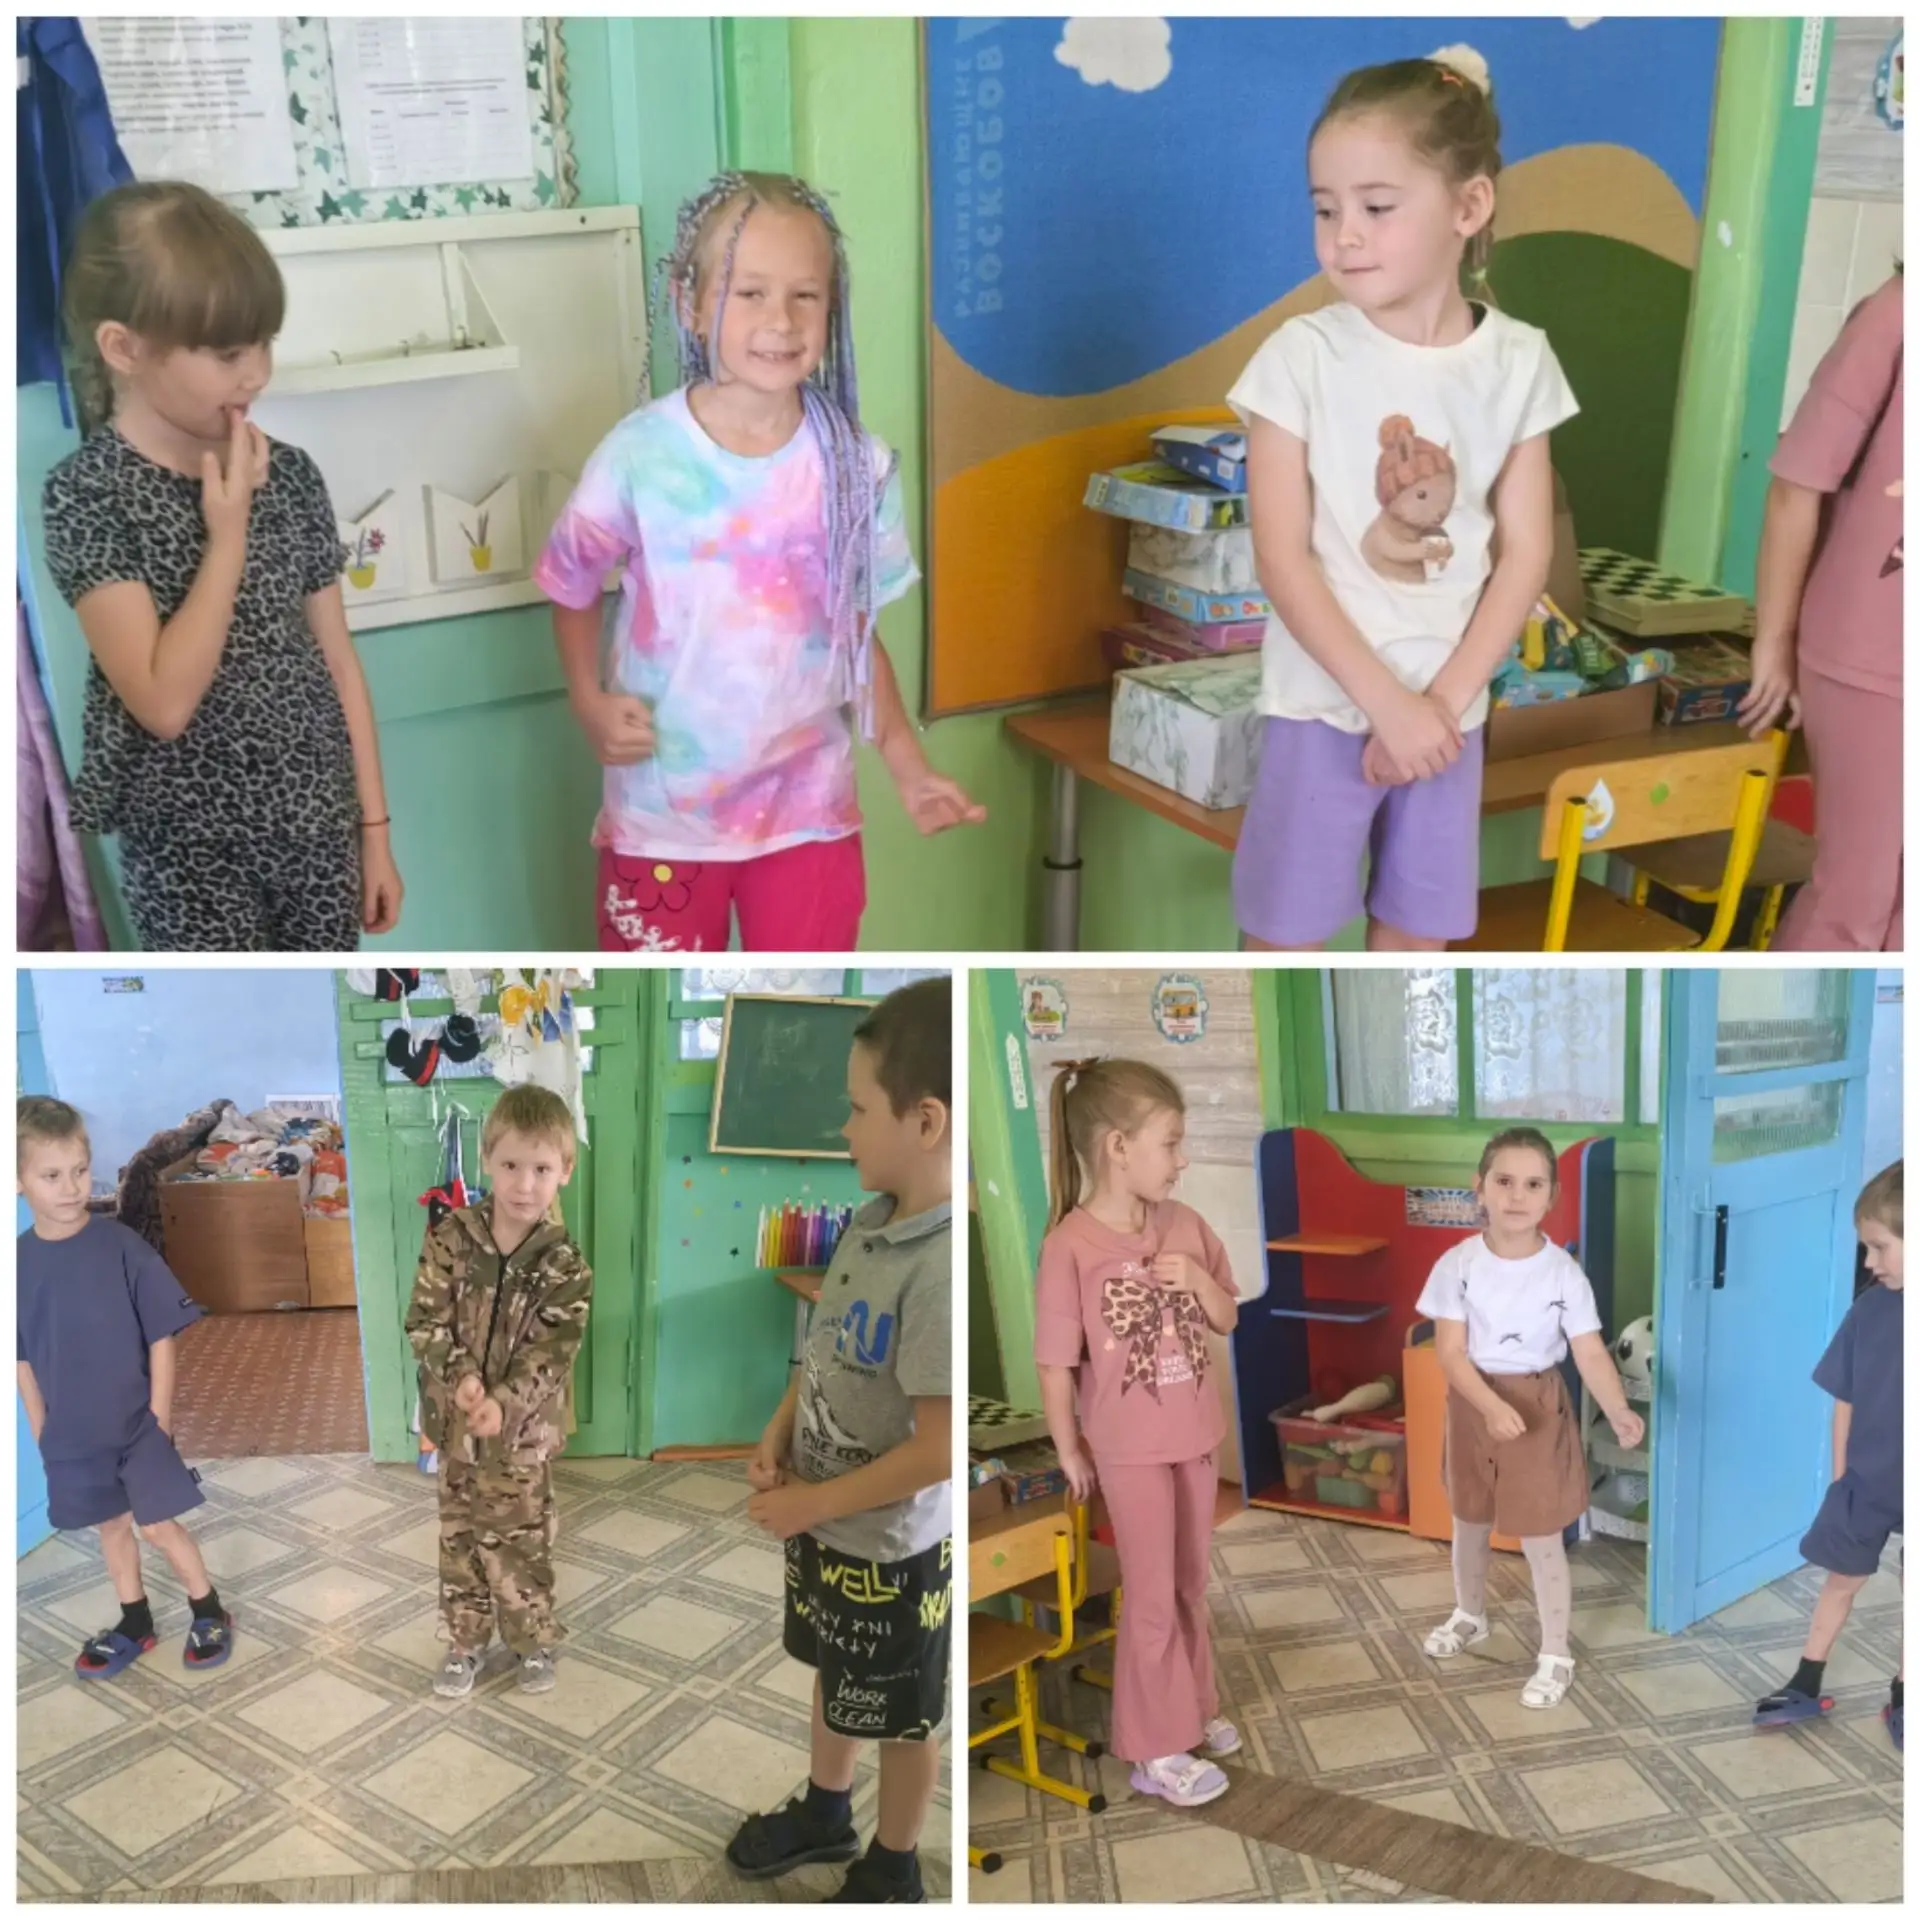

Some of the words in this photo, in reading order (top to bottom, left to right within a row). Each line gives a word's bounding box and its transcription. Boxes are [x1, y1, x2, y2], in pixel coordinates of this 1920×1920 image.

[819, 1558, 900, 1604] WELL
[837, 1680, 888, 1706] WORK
[828, 1701, 887, 1725] CLEAN
